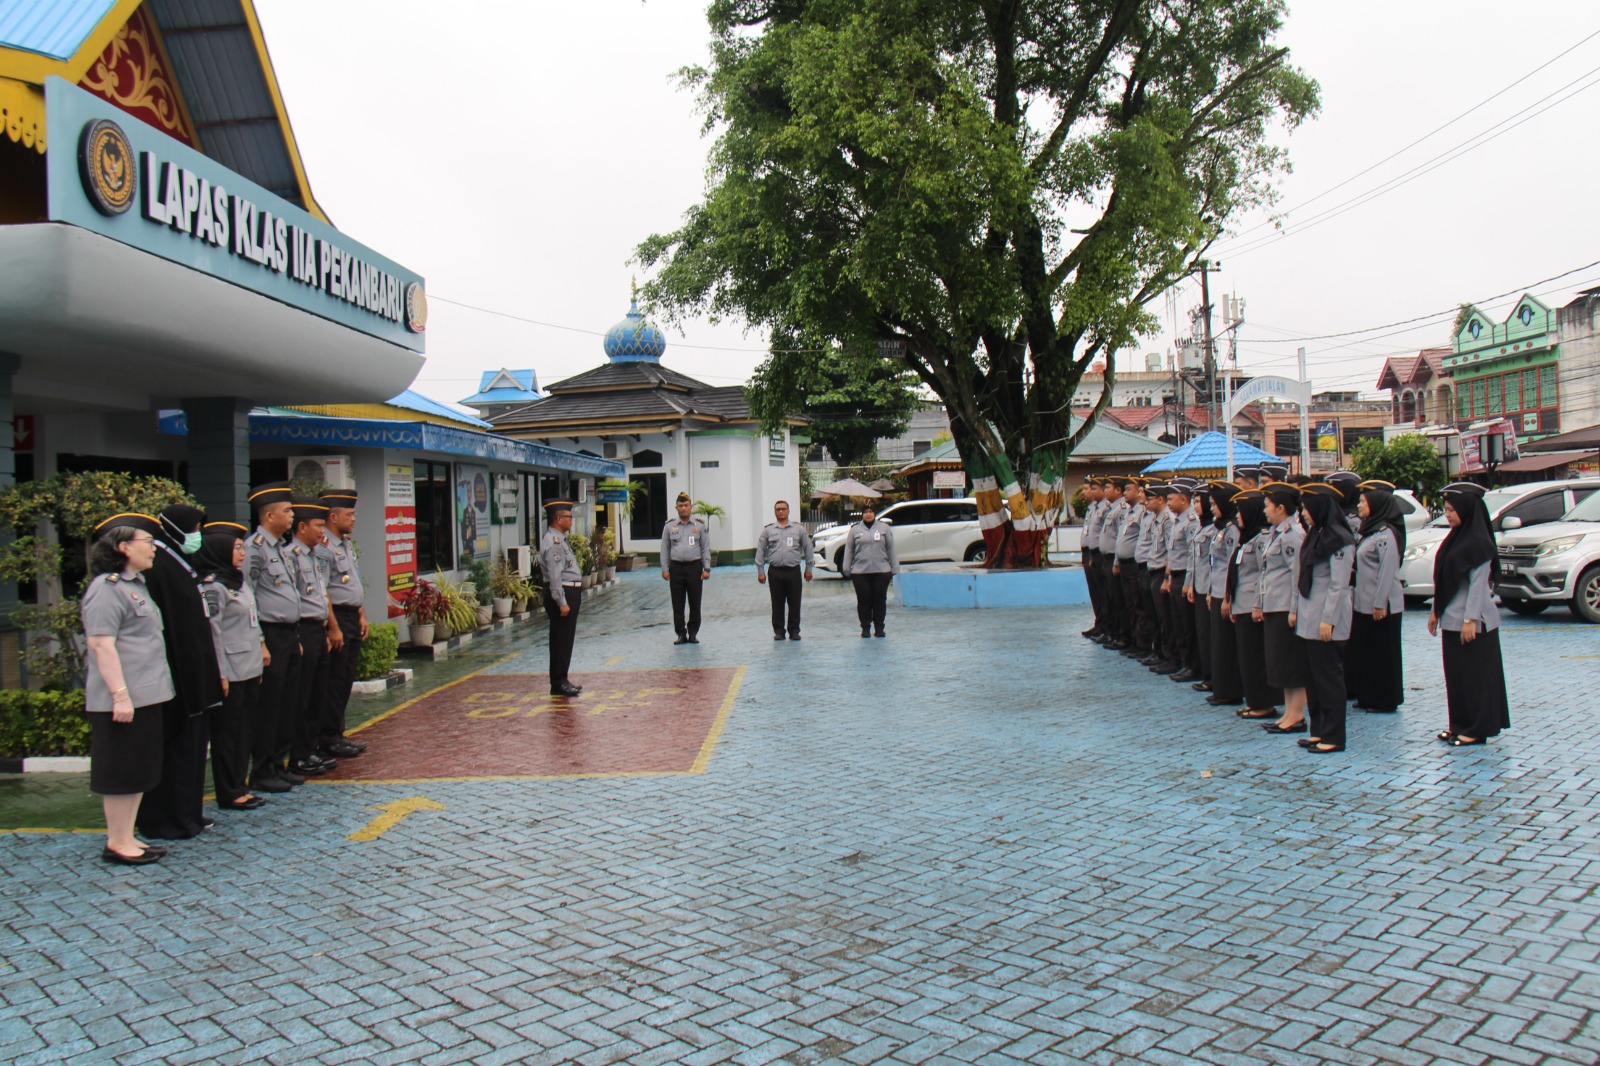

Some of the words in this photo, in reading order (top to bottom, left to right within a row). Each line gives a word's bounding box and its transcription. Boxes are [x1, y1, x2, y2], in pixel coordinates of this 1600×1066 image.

[143, 151, 229, 248] LAPAS
[232, 195, 288, 273] KLAS
[291, 225, 318, 290] IIA
[318, 239, 405, 323] PEKANBARU
[1240, 380, 1264, 404] SELAMAT
[1265, 379, 1286, 394] JALAN
[461, 686, 685, 704] DROP
[465, 701, 651, 719] OFF
